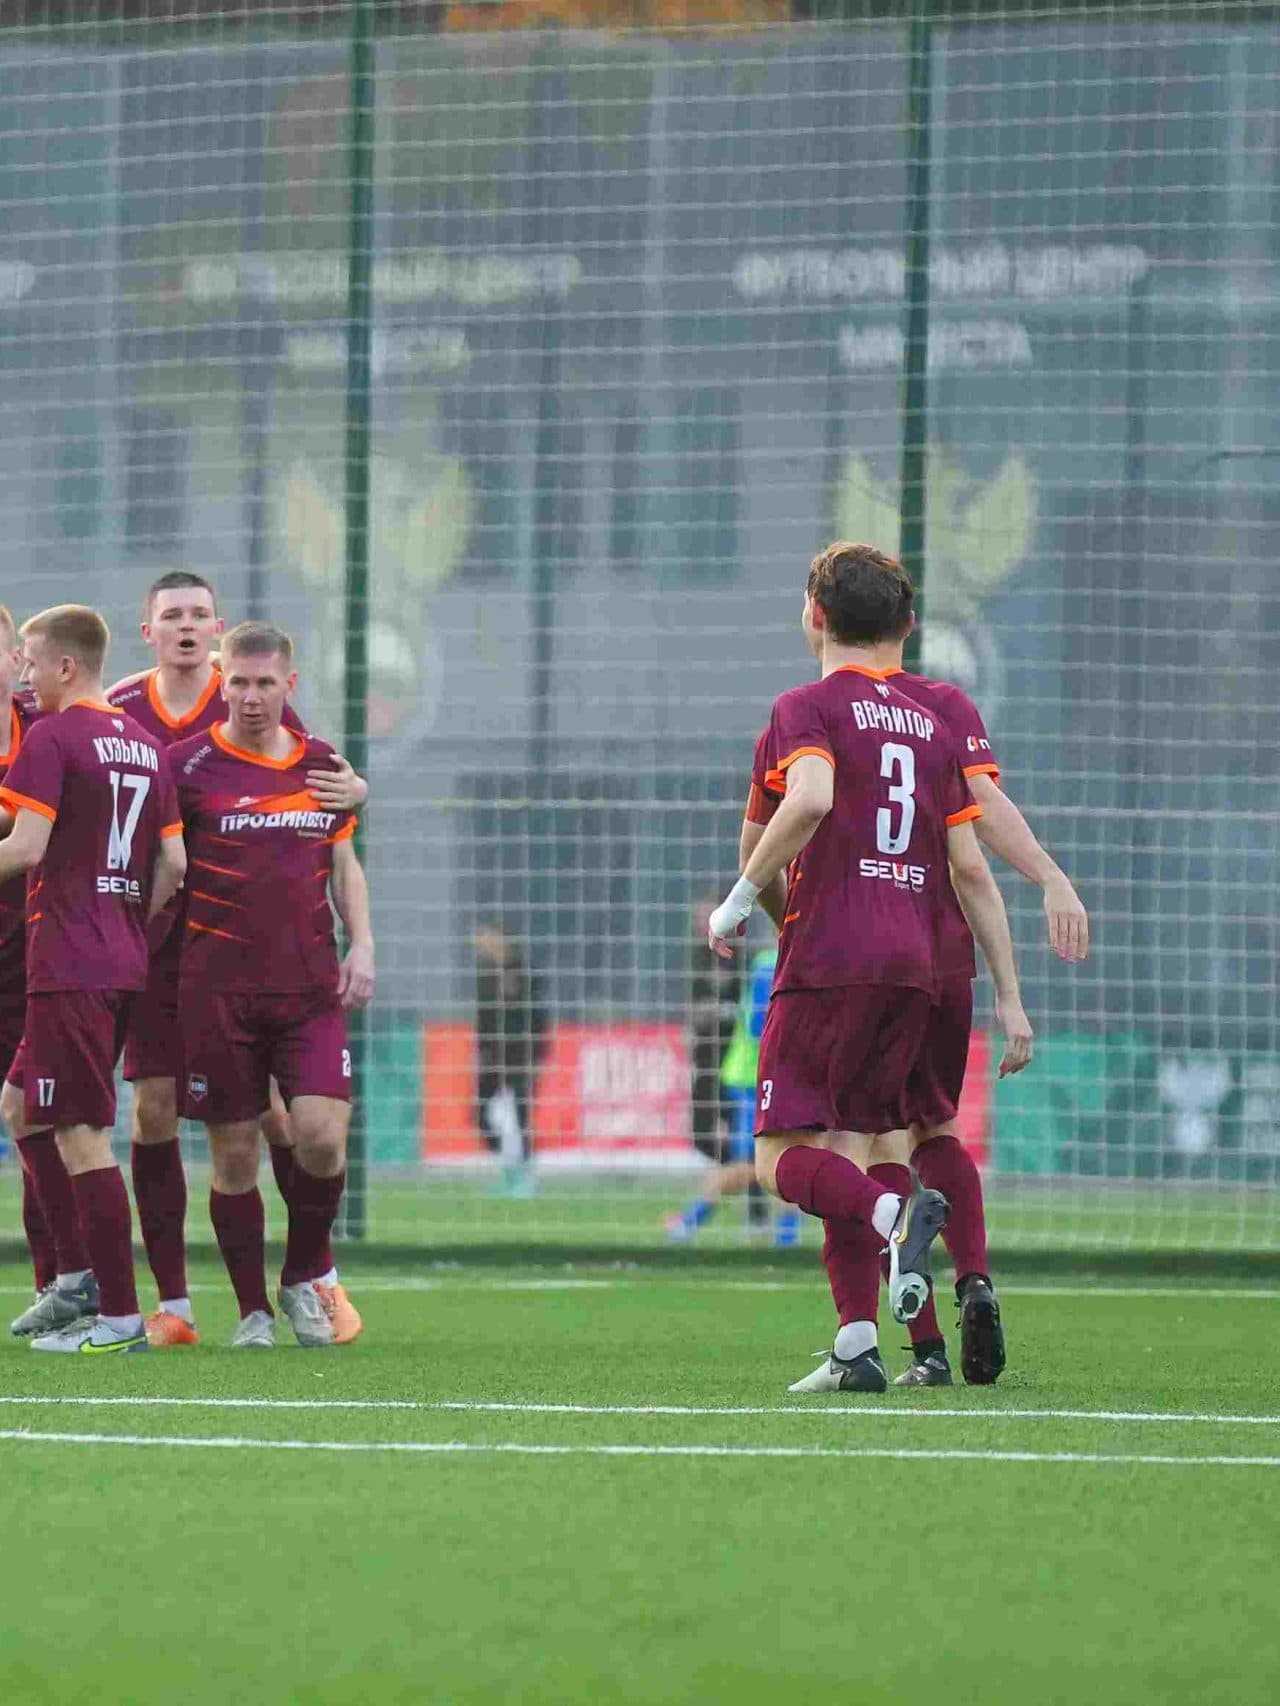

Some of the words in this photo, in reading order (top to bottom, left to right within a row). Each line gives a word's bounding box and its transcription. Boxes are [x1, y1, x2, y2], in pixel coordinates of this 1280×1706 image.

[93, 736, 159, 772] КУЗЬКИН
[876, 741, 916, 855] 3
[107, 770, 151, 872] 17
[859, 858, 925, 885] SEUS
[37, 1077, 56, 1107] 17
[761, 1078, 774, 1111] 3
